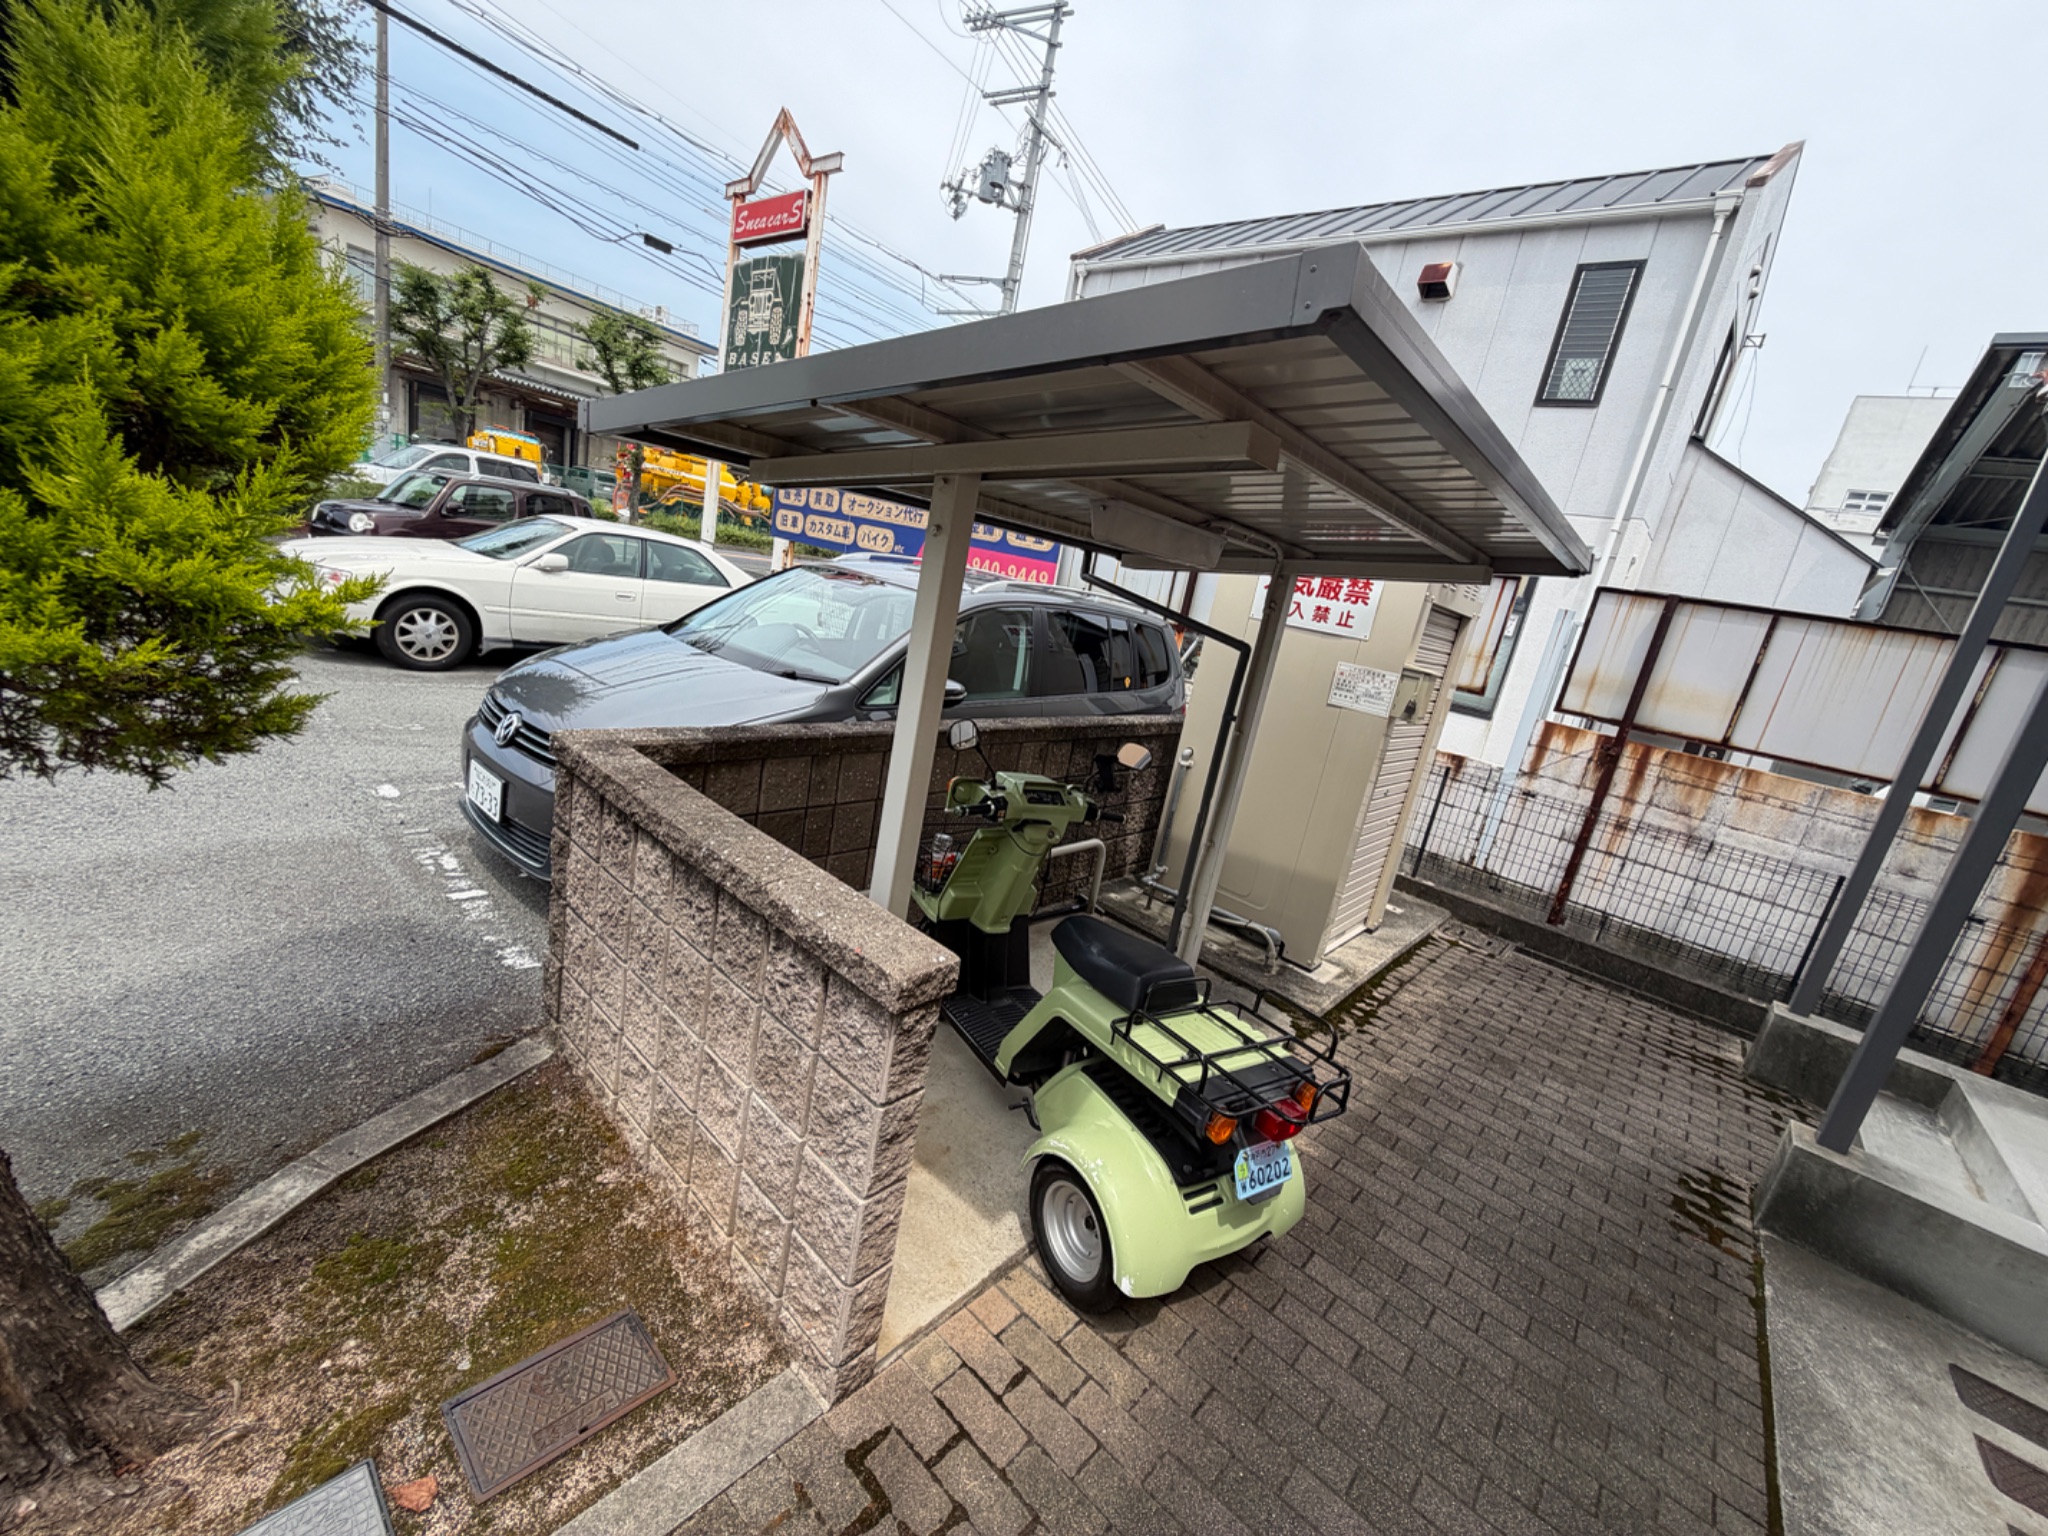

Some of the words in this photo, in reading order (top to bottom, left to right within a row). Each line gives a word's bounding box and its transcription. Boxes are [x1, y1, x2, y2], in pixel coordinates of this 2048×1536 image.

[814, 491, 834, 508] 買取
[848, 497, 924, 524] オークション代行
[781, 513, 799, 528] 旧車
[810, 520, 851, 540] カスタム車
[861, 530, 889, 548] バイク
[1249, 1157, 1290, 1189] 60202
